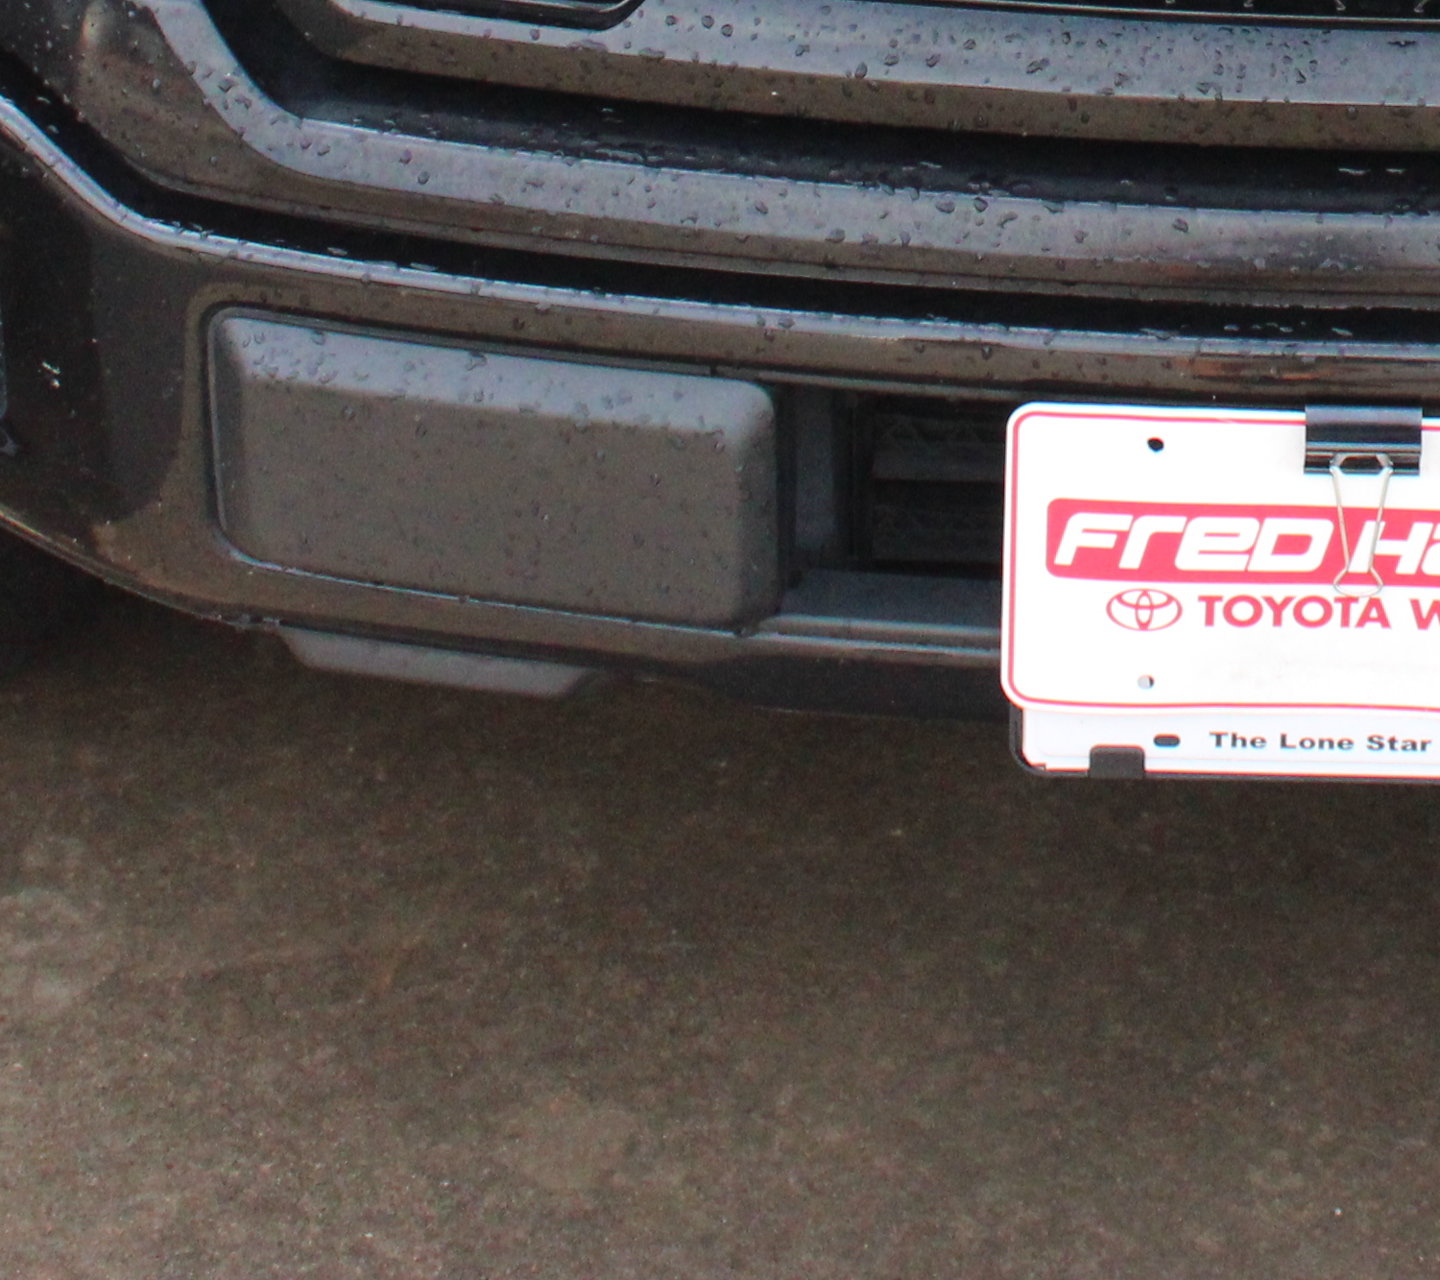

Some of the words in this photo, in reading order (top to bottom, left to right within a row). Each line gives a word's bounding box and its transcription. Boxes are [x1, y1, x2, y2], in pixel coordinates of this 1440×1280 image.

[1198, 594, 1391, 630] TOYOTA
[1209, 732, 1267, 750] The
[1279, 733, 1355, 751] Lone
[1365, 734, 1433, 753] Star
